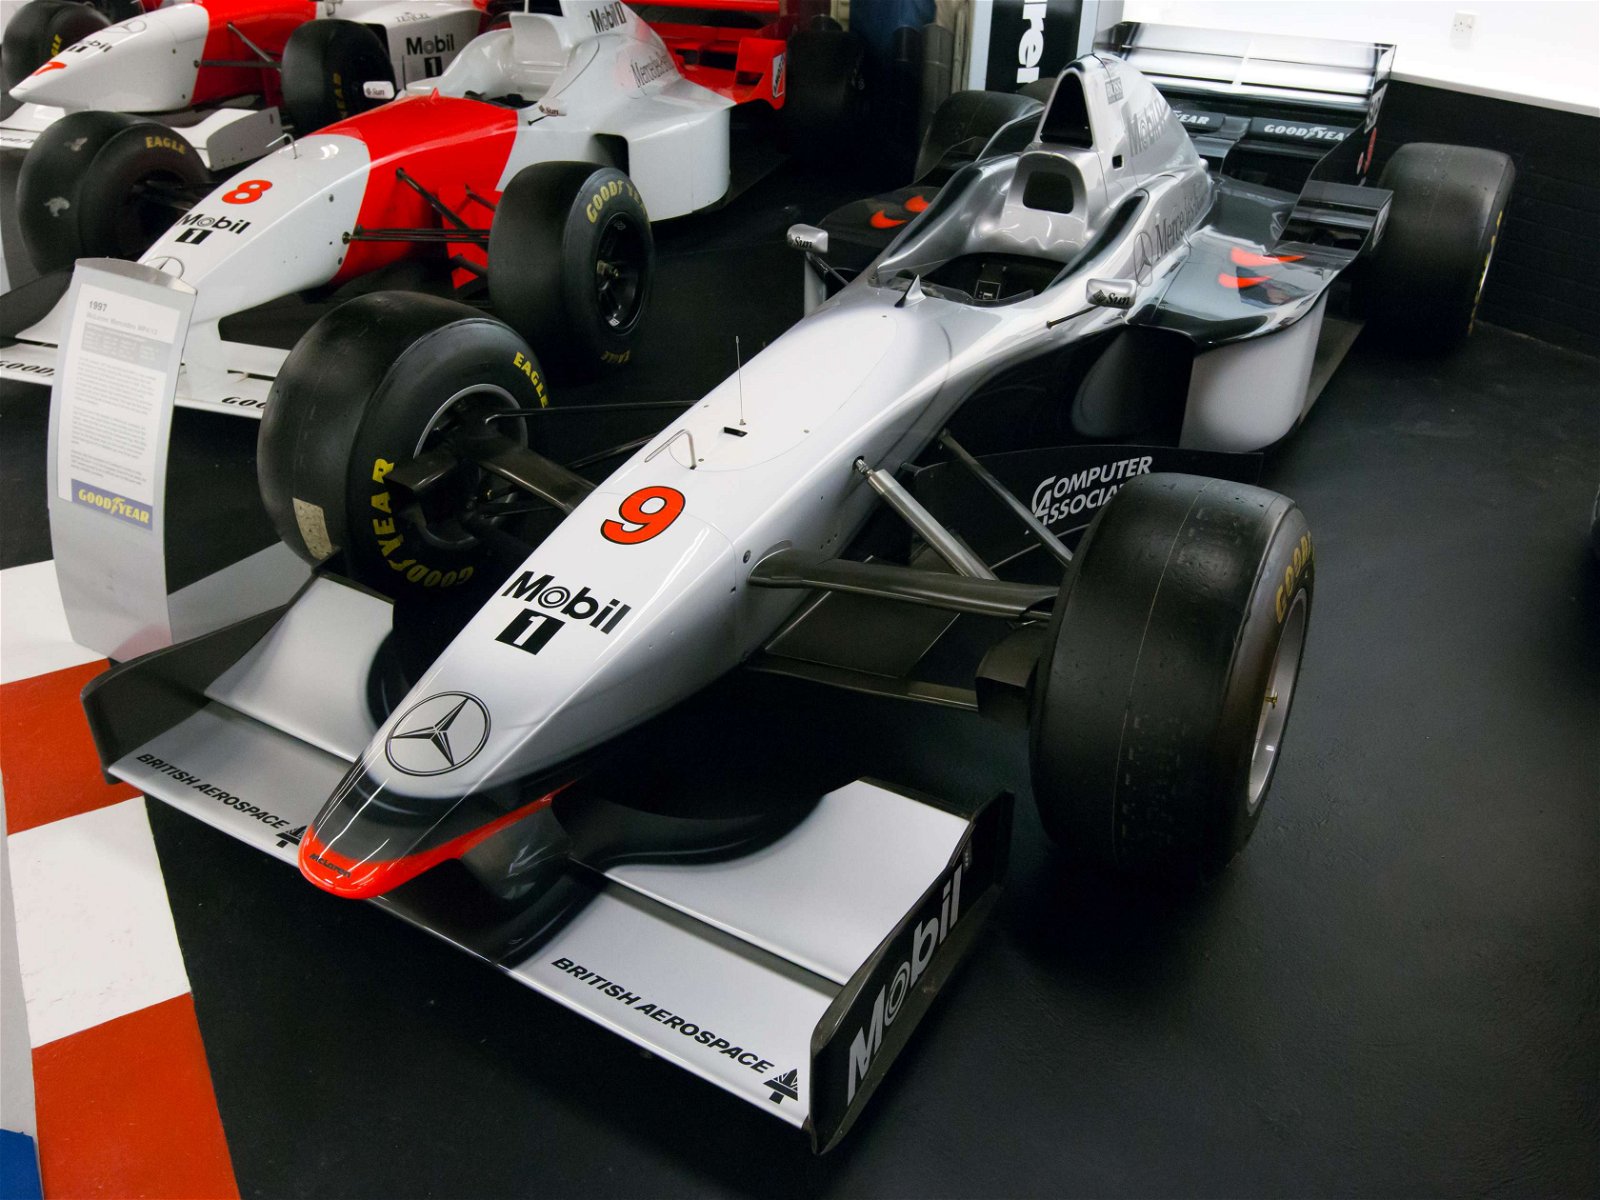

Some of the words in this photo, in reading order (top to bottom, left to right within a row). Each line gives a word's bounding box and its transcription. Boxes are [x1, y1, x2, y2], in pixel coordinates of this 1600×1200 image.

[406, 34, 455, 55] Mobil
[145, 136, 186, 155] EAGLE
[221, 179, 273, 205] 8
[176, 213, 252, 235] Mobil
[795, 236, 813, 249] Sun
[89, 300, 107, 312] 1997
[1107, 292, 1131, 305] Sun
[513, 351, 549, 408] EAGLE
[1032, 456, 1153, 513] COMPUTER
[78, 489, 150, 524] GOODYEAR
[601, 485, 686, 545] 9
[501, 570, 632, 634] Mobil
[136, 753, 201, 786] BRITISH
[192, 783, 290, 829] AEROSPACE
[847, 863, 962, 1107] Mobil
[551, 957, 642, 1005] BRITISH
[635, 1003, 775, 1074] AEROSPACE
